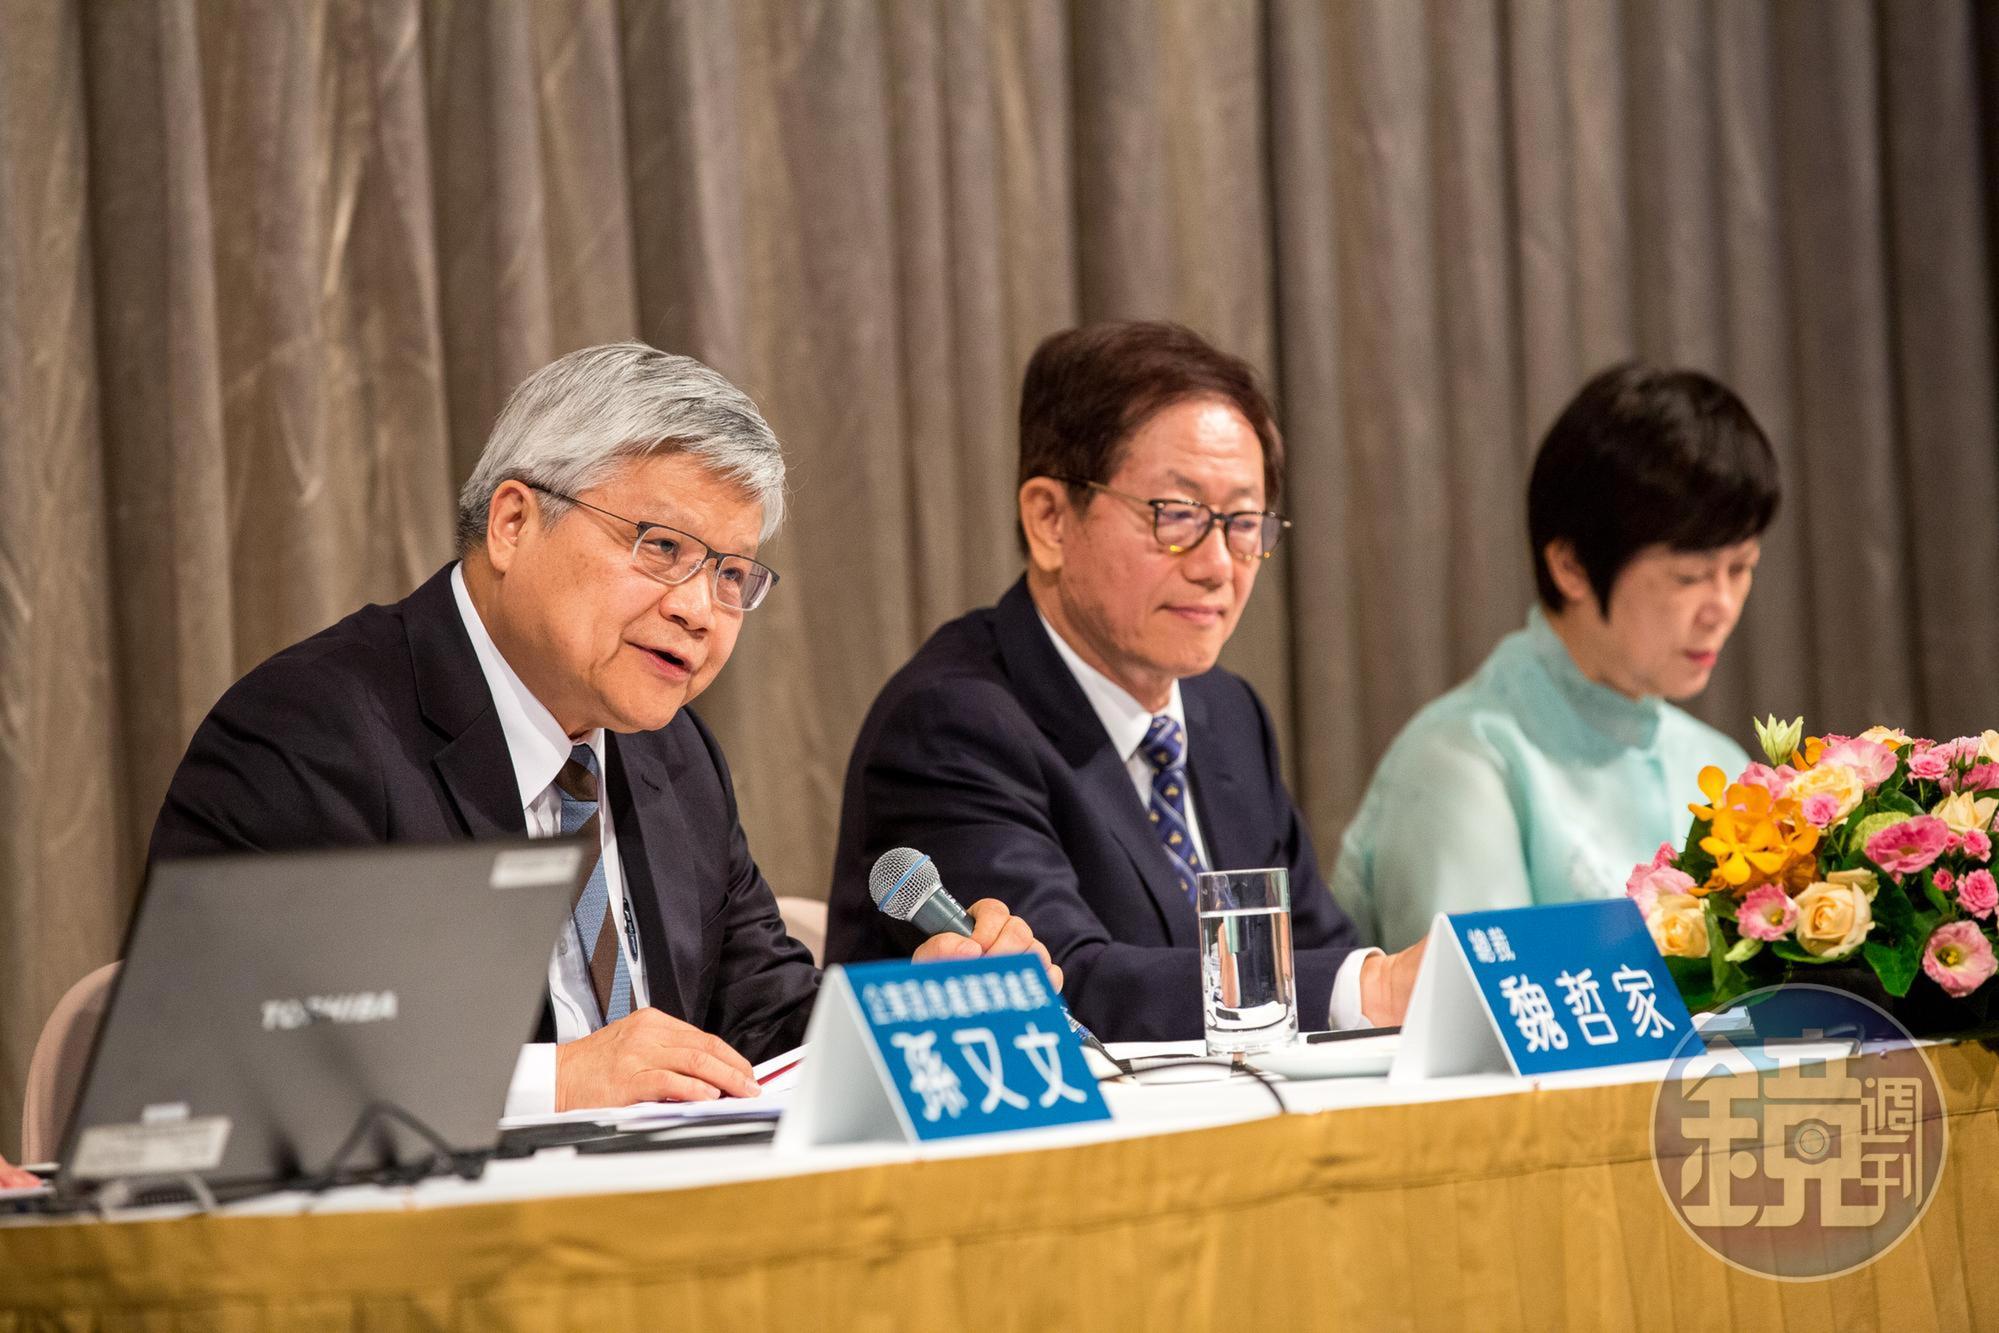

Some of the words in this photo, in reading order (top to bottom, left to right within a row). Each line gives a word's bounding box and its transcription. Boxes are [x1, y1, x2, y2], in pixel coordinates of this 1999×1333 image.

[1499, 964, 1675, 1053] 魏哲家
[890, 1021, 1087, 1121] 孫又文
